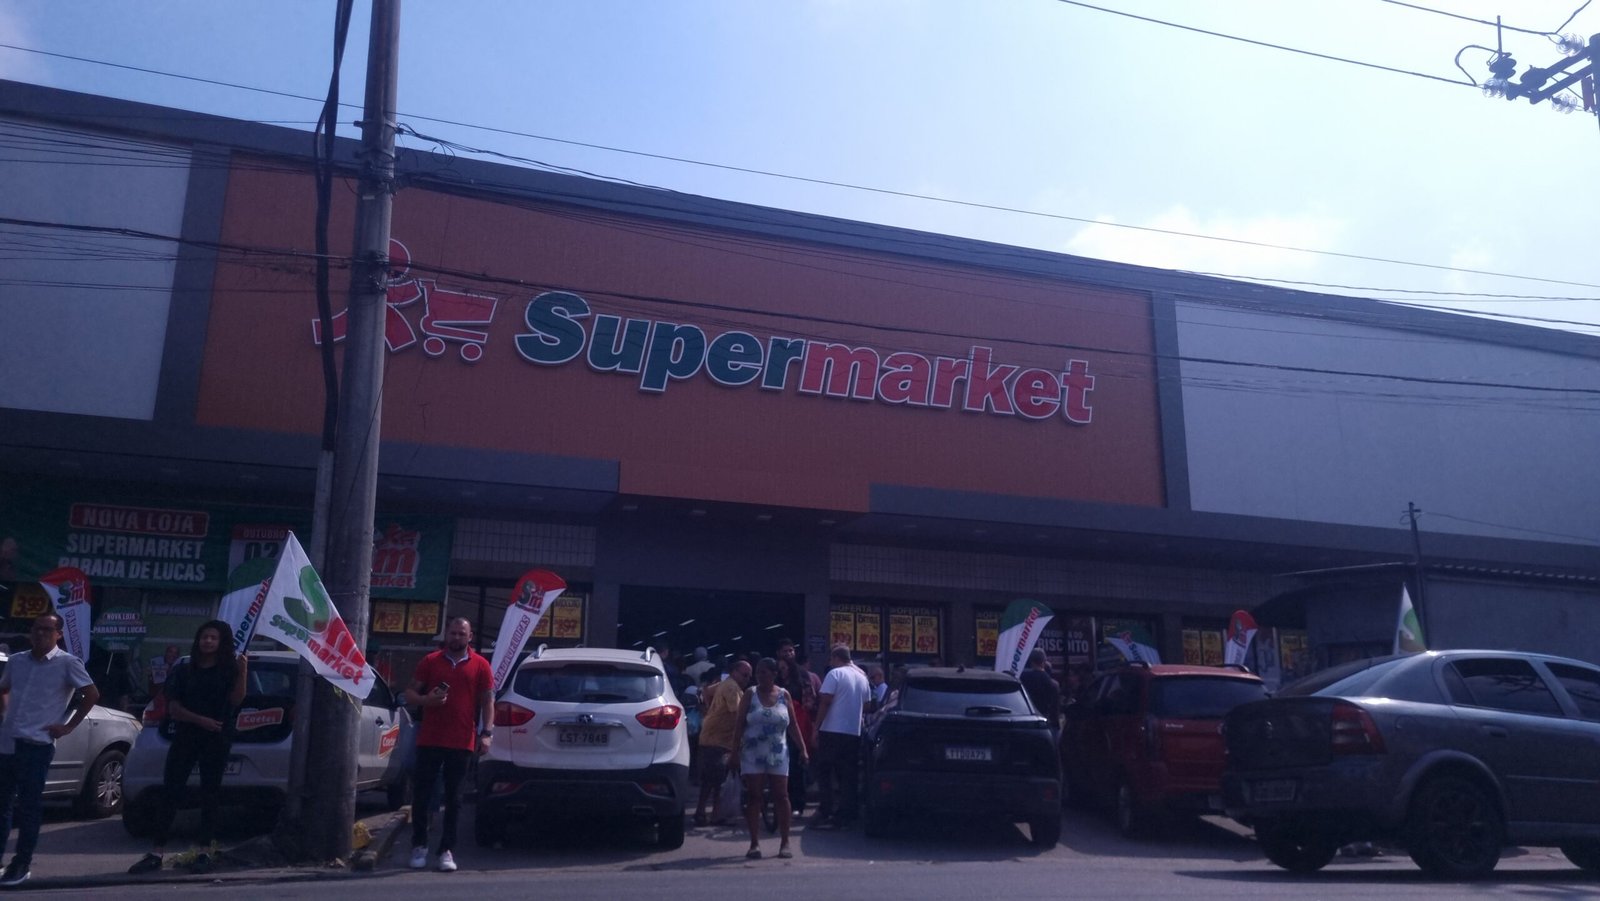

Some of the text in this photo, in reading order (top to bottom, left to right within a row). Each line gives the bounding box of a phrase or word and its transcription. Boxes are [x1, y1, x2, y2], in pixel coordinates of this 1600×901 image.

[514, 290, 1095, 424] Supermarket
[81, 507, 195, 534] NOVA LOJA
[66, 533, 205, 562] SUPERMARKET
[128, 560, 150, 580] DE
[153, 562, 207, 583] LUCAS
[270, 614, 364, 686] Supermarket
